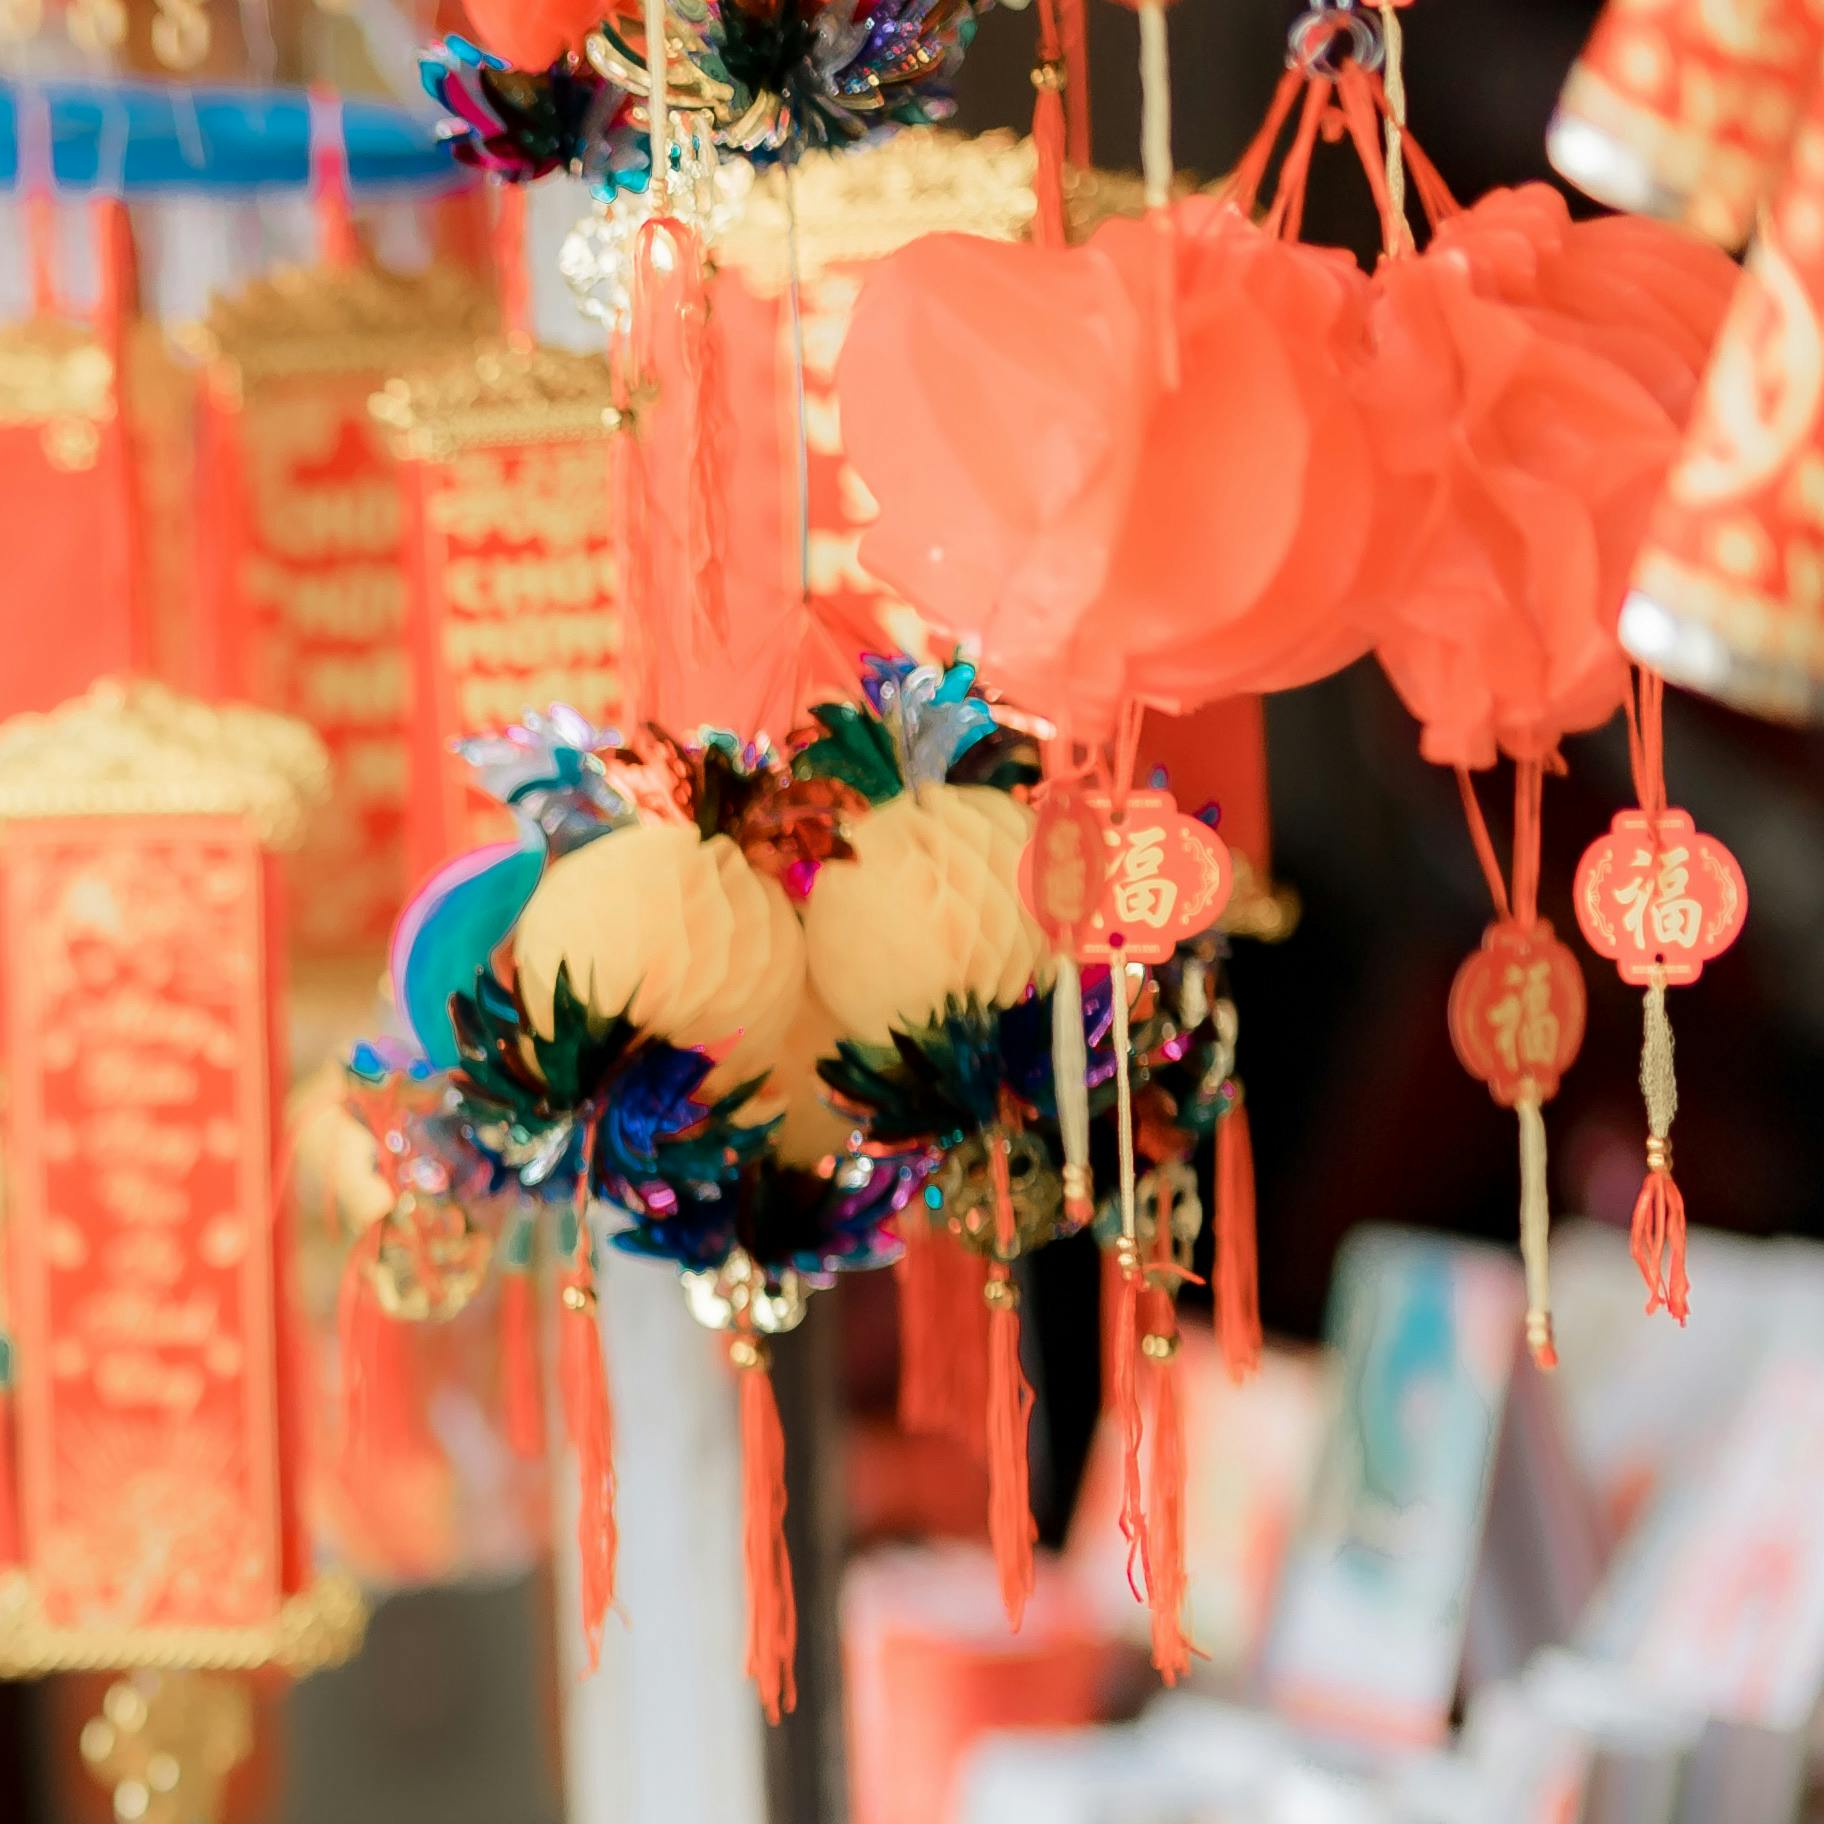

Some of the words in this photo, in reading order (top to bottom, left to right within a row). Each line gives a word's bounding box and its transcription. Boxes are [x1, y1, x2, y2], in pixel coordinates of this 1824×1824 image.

[1092, 826, 1178, 929] 福
[1613, 846, 1702, 949] 福
[1488, 960, 1560, 1072] 福
